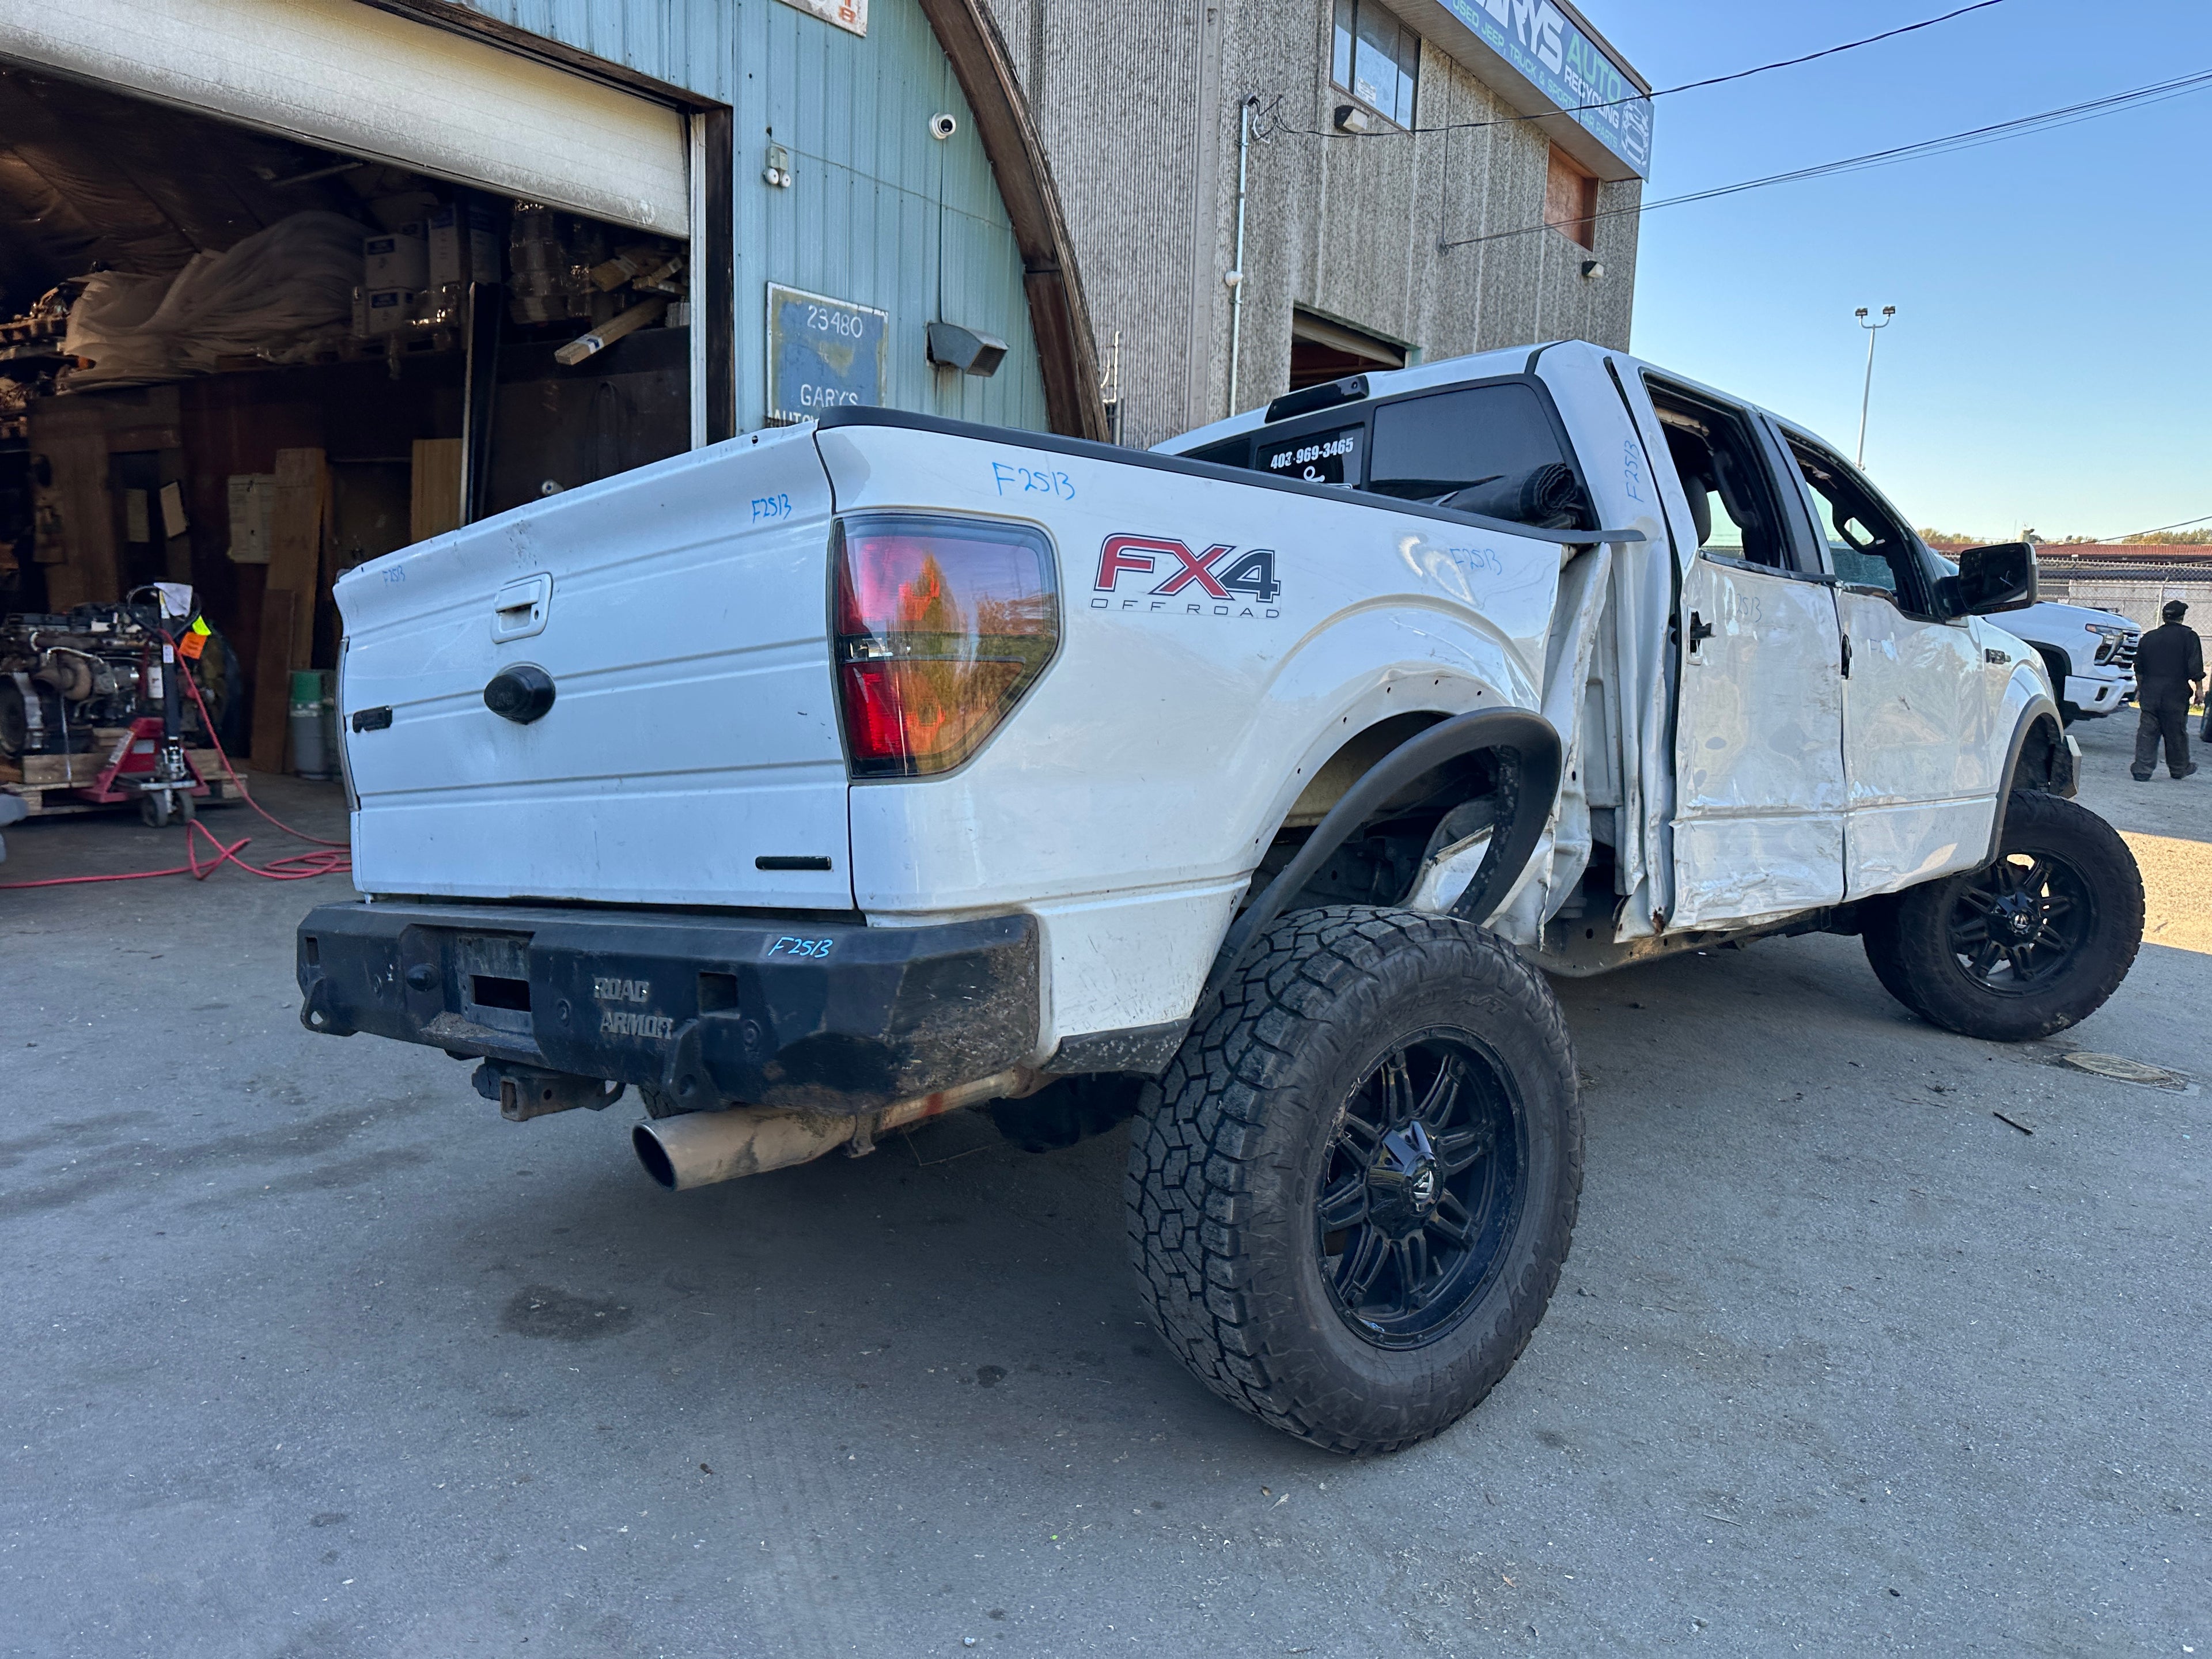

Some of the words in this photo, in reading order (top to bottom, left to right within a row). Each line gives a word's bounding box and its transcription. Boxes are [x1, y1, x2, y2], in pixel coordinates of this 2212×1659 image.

[1567, 32, 1622, 108] AUTO
[1509, 43, 1537, 79] TRUCK
[1547, 78, 1577, 114] SPORTS
[1596, 121, 1618, 149] PARTS
[1564, 65, 1619, 129] RECYCLING
[807, 305, 862, 338] 23480
[1270, 437, 1354, 469] 403-969-3465
[992, 462, 1075, 500] F2513
[1624, 440, 1645, 502] F2513
[752, 494, 791, 524] F2513
[1093, 532, 1281, 603] FX4
[1450, 548, 1502, 575] F2513
[768, 937, 833, 959] F2513
[600, 1011, 673, 1040] ARMOR
